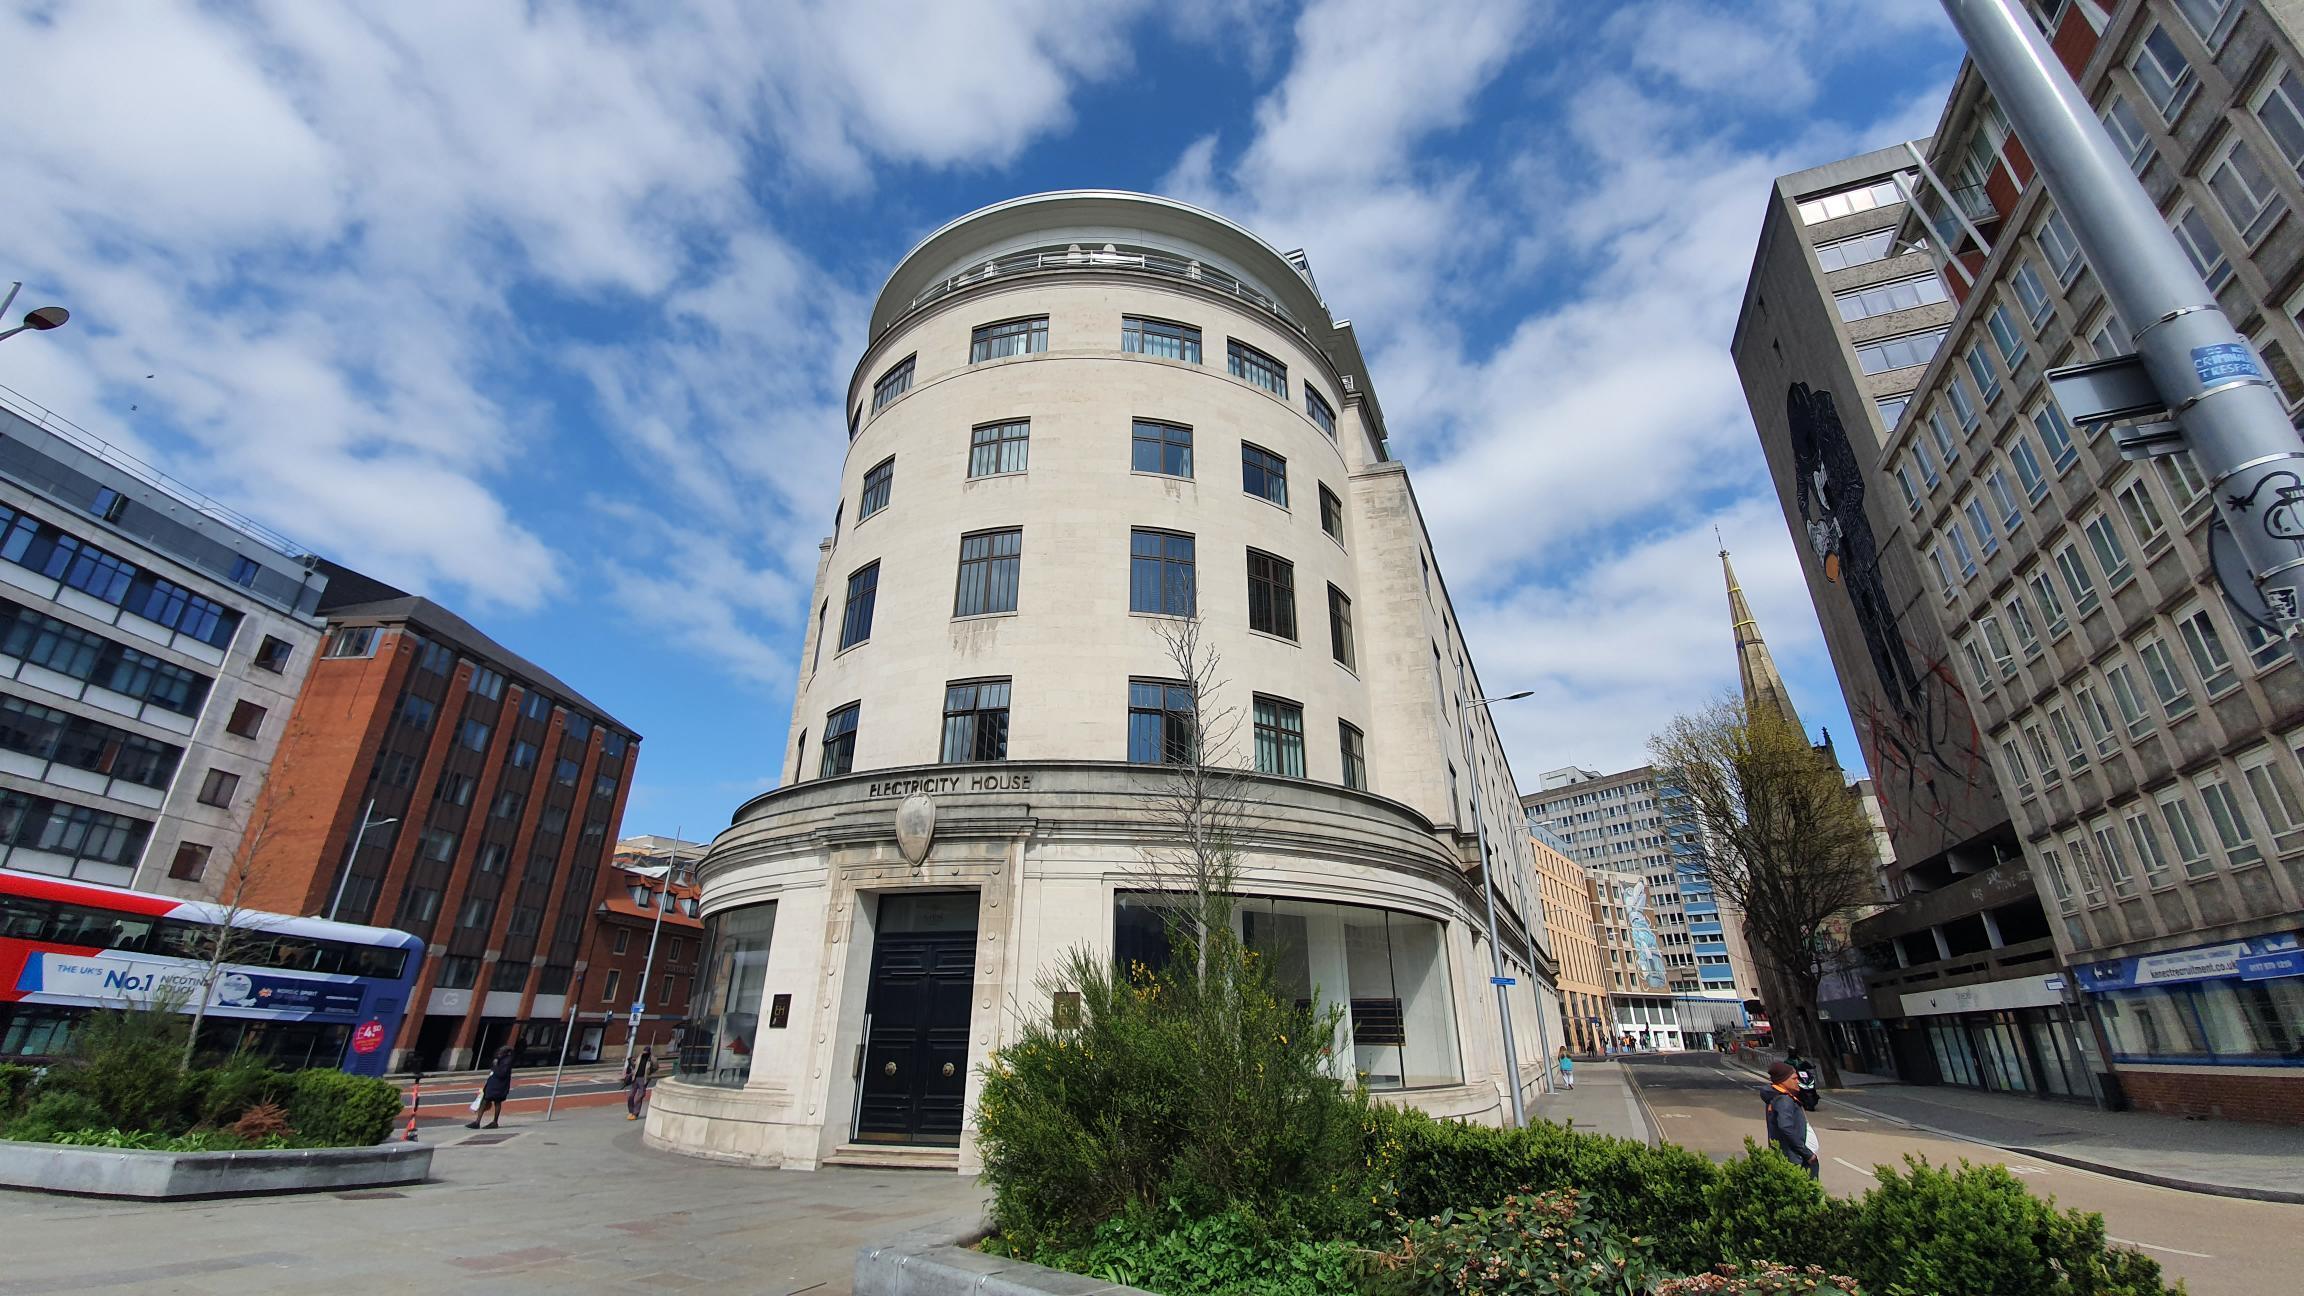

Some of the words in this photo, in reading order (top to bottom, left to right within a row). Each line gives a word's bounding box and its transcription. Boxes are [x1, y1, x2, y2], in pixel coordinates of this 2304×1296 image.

[869, 777, 960, 797] ELECTRICITY
[971, 775, 1032, 790] HOUSE
[57, 964, 77, 974] THE
[80, 966, 103, 976] UK'S
[104, 970, 154, 992] No.1
